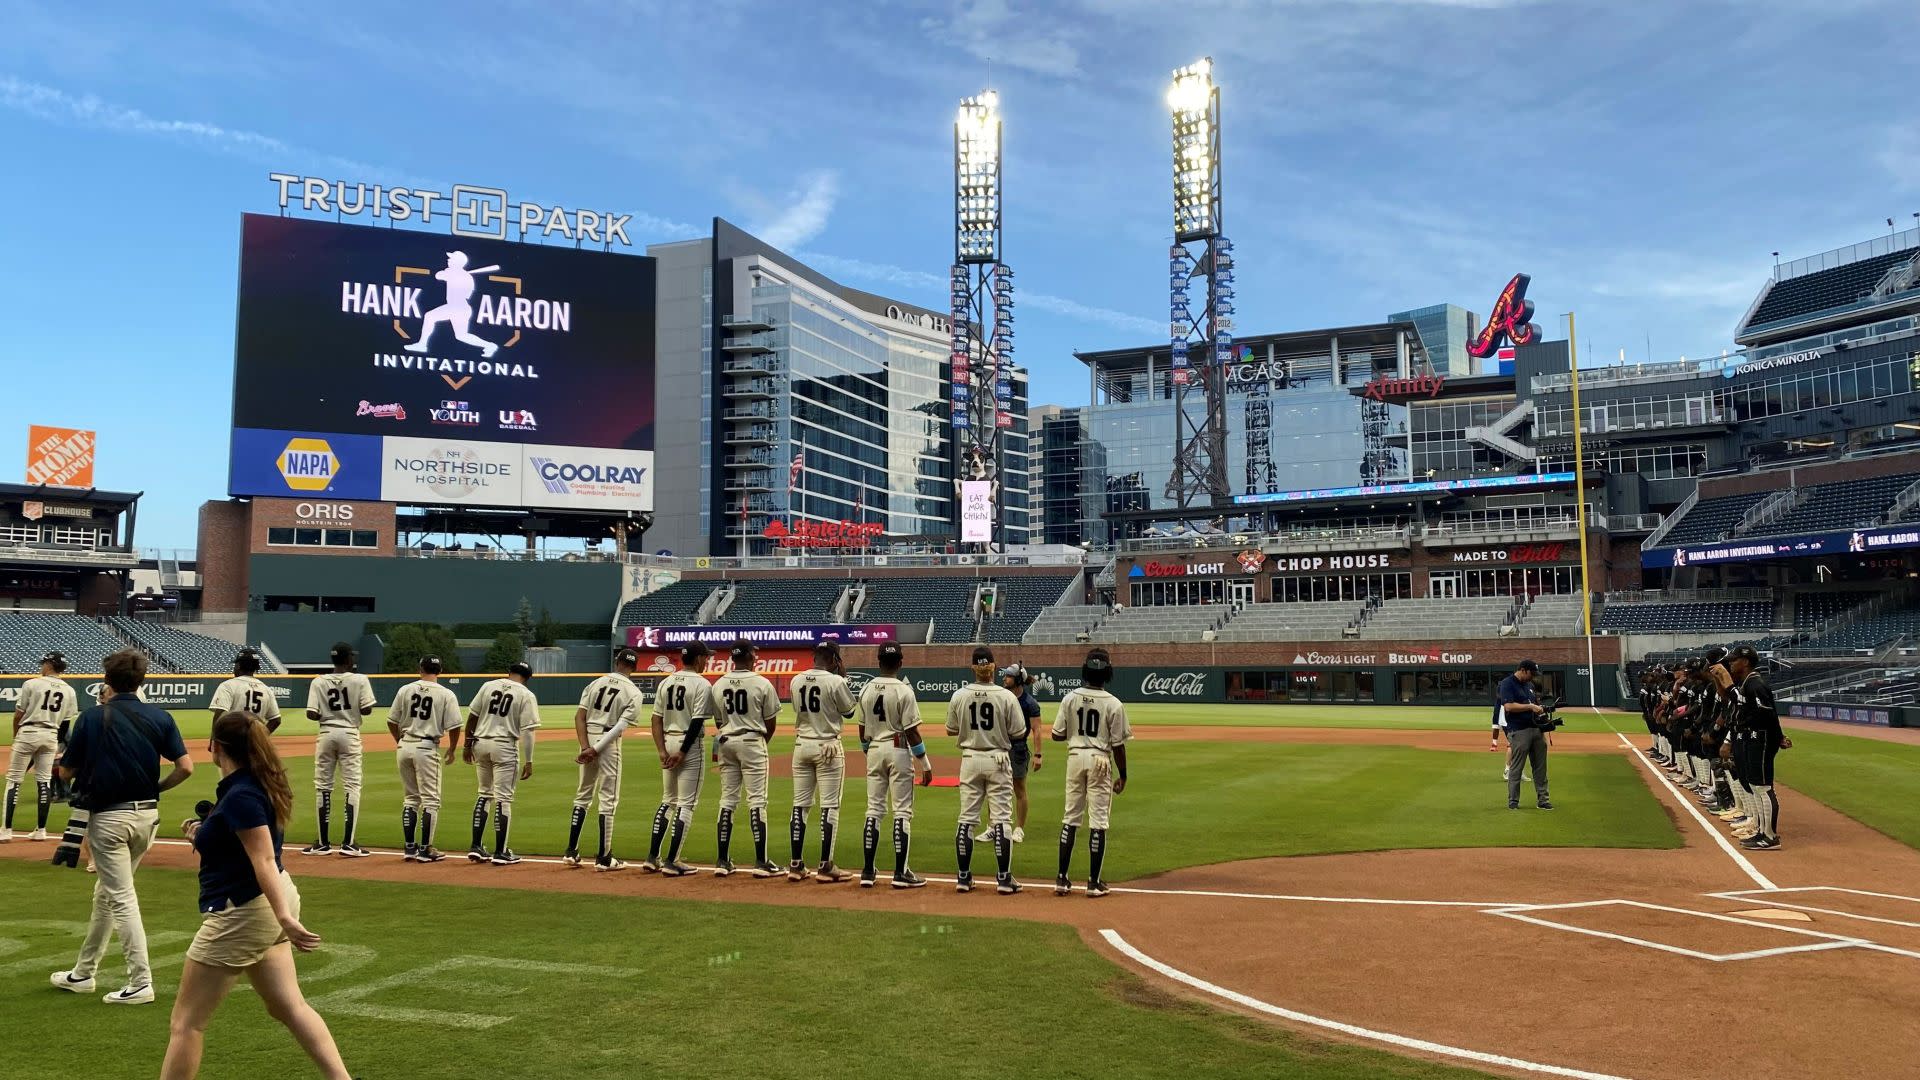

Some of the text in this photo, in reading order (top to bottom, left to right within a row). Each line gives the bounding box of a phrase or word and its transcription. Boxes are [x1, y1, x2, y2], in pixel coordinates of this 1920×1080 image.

[270, 172, 632, 246] TRUIST PARK
[954, 267, 966, 276] 1872
[342, 281, 570, 332] HANK AARON
[954, 297, 966, 306] 1877
[1174, 326, 1186, 334] 2010
[1218, 320, 1231, 328] 2012
[1174, 341, 1186, 350] 2013
[1218, 352, 1231, 360] 2020
[1736, 350, 1821, 376] KONICA MINOLTA
[374, 353, 538, 378] INVITATIONAL
[1186, 359, 1297, 387] CMCAST
[954, 372, 966, 381] 1957
[1174, 373, 1186, 381] 2021
[1364, 372, 1444, 400] xfinity
[356, 400, 398, 416] Braves
[430, 408, 480, 423] YOUTH
[954, 416, 966, 425] 1993
[998, 416, 1010, 424] 1995
[35, 433, 64, 456] THE
[27, 430, 96, 484] HOME
[288, 453, 330, 476] NAPA
[53, 451, 93, 486] DEPOT
[394, 458, 511, 476] NORTHSIDE
[541, 462, 647, 485] COOLRAY
[416, 475, 490, 487] HOSPITAL
[576, 490, 607, 498] Plumbing
[970, 494, 983, 502] EAT
[44, 505, 92, 517] CLUBHOUSE
[296, 503, 354, 520] ORIS
[968, 503, 984, 511] MOR
[1868, 533, 1919, 546] HANK AARON
[1454, 543, 1564, 564] MADE TO Chill
[1688, 552, 1706, 561] HANK
[1706, 550, 1729, 560] AARON
[1730, 545, 1776, 558] INVITATIONAL
[1146, 561, 1185, 576] Coors
[1186, 562, 1224, 576] LIGHT
[1278, 557, 1324, 571] CHOP
[1330, 555, 1389, 569] HOUSE
[666, 631, 696, 642] HANK
[698, 631, 736, 642] AARON
[740, 630, 815, 641] INVITATIONAL
[753, 656, 793, 672] arm
[1307, 652, 1376, 665] Coors LIGHT
[1389, 653, 1428, 664] BELOW
[1442, 652, 1472, 664] CHOP
[1576, 668, 1590, 676] 325
[917, 680, 960, 694] Georgia
[1058, 678, 1082, 686] KAISER
[1141, 672, 1208, 696] Coca-Cola
[41, 690, 64, 712] 13
[244, 690, 263, 714] 15
[327, 687, 351, 712] 21
[489, 690, 514, 717] 20
[594, 686, 620, 713] 17
[666, 685, 686, 712] 18
[722, 688, 748, 715] 30
[800, 685, 820, 713] 16
[410, 694, 433, 720] 29
[873, 695, 886, 722] 4
[968, 702, 994, 731] 19
[1076, 707, 1100, 738] 10
